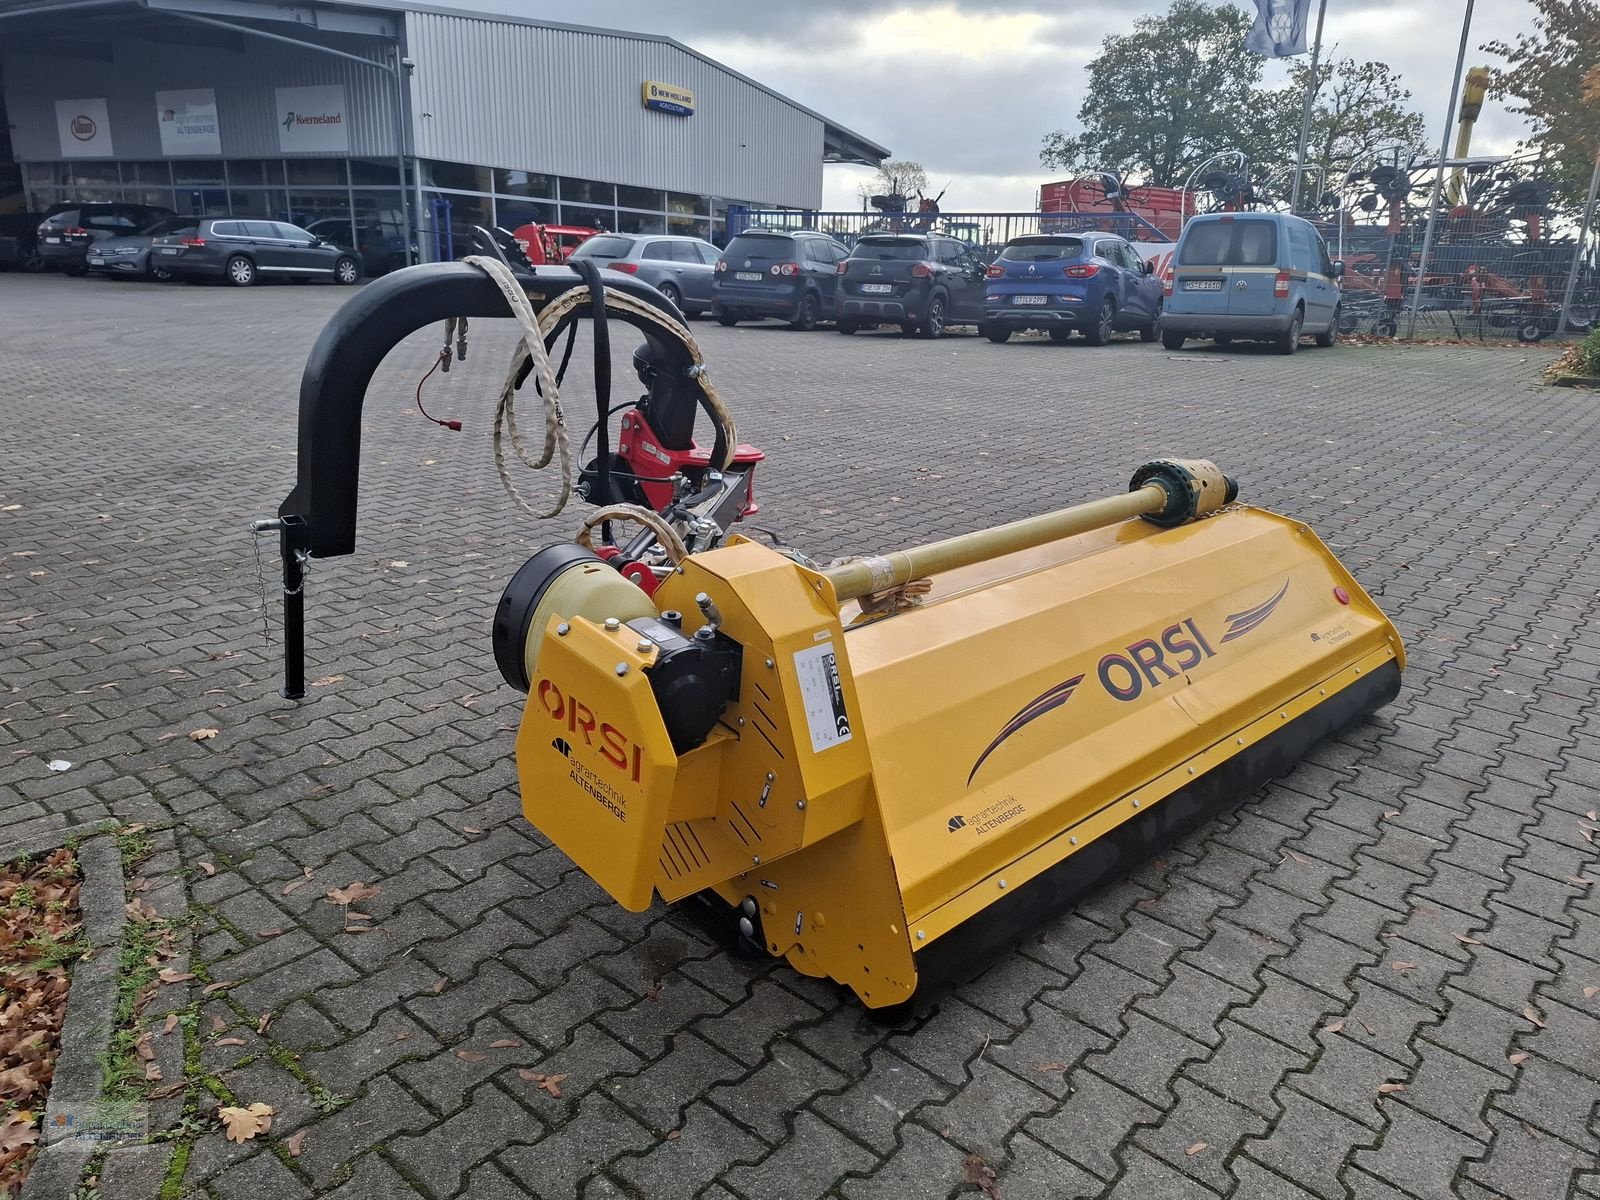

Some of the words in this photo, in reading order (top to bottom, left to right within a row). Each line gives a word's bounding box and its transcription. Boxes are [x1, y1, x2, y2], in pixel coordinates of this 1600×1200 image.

[658, 89, 669, 98] NEW
[670, 92, 691, 103] HOLLAND
[177, 125, 215, 134] ALTENBERGE
[296, 112, 341, 125] Kverneland
[829, 653, 842, 690] ORSI
[1096, 617, 1217, 702] ORSI
[537, 679, 643, 784] ORSI
[569, 757, 628, 809] agrartechnik
[569, 769, 627, 823] ALTENBERGE
[966, 793, 1018, 826] agrartechnik
[975, 804, 1027, 836] ALTENBERGE
